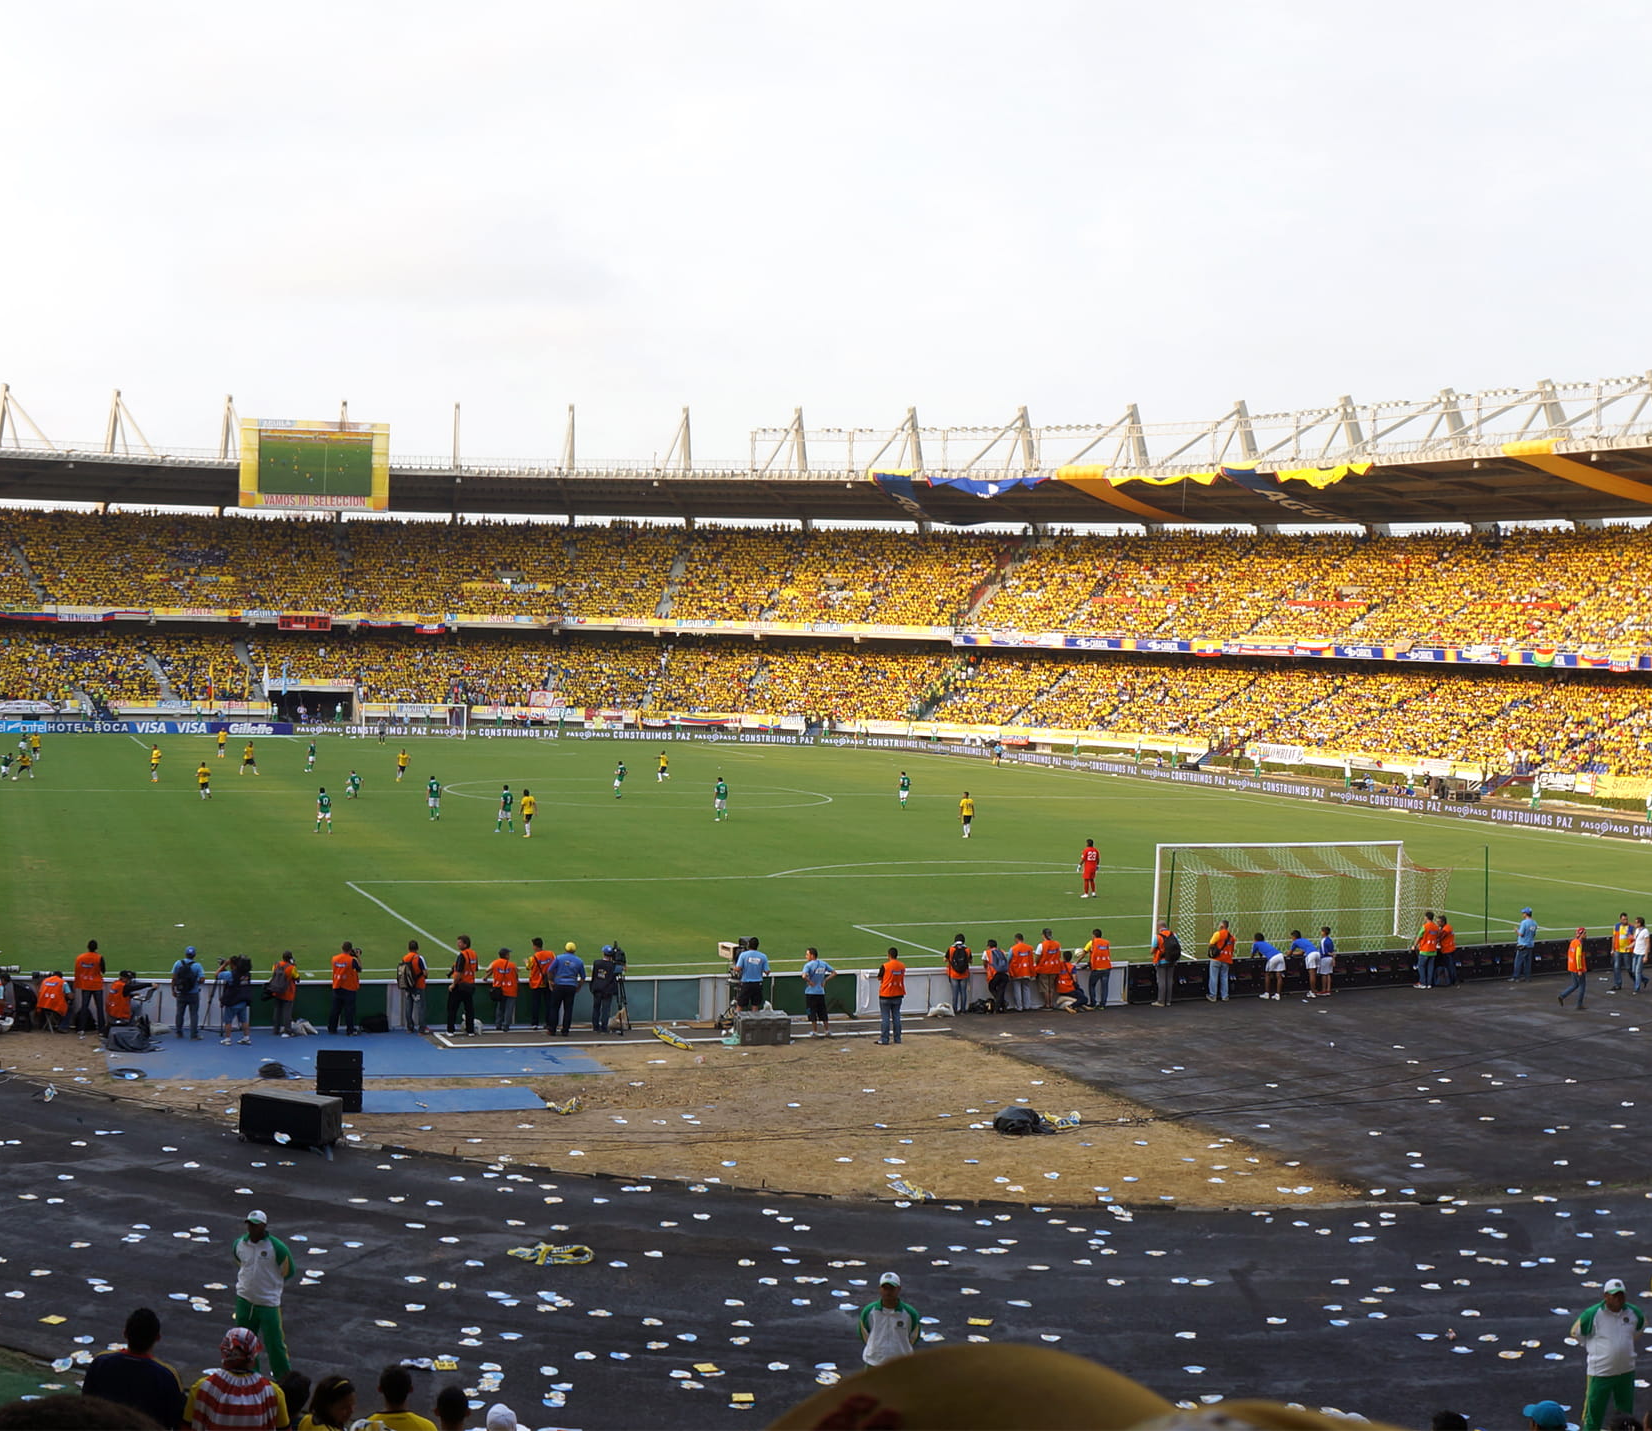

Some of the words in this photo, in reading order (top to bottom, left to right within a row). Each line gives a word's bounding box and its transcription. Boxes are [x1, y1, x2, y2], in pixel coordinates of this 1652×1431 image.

[264, 495, 295, 507] VAMOS
[298, 496, 310, 507] MI
[313, 496, 366, 508] SELECCION
[48, 722, 88, 732] HOTEL
[94, 722, 129, 732] BOCA
[136, 722, 167, 733] VISA
[177, 722, 208, 733] VISA
[229, 721, 274, 735] Gillette
[411, 726, 427, 736] PAZ
[479, 729, 540, 737] CONSTRUIMOS
[543, 730, 559, 738] PAZ
[613, 731, 673, 740] CONSTRUIMOS
[676, 731, 691, 740] PAZ
[740, 734, 796, 744] CONSTRUIMOS
[799, 736, 814, 745] PAZ
[867, 738, 917, 749] CONSTRUIMOS
[1171, 771, 1212, 785] CONSTRUIMOS
[1214, 775, 1226, 786] PAZ
[1263, 781, 1309, 795] CONSTRUIMOS
[1312, 786, 1325, 798] PAZ
[1370, 795, 1424, 811] CONSTRUIMOS
[1426, 800, 1442, 812] PAZ
[1491, 808, 1553, 826] CONSTRUIMOS
[1556, 815, 1573, 829] PAZ
[1609, 823, 1629, 834] PASO
